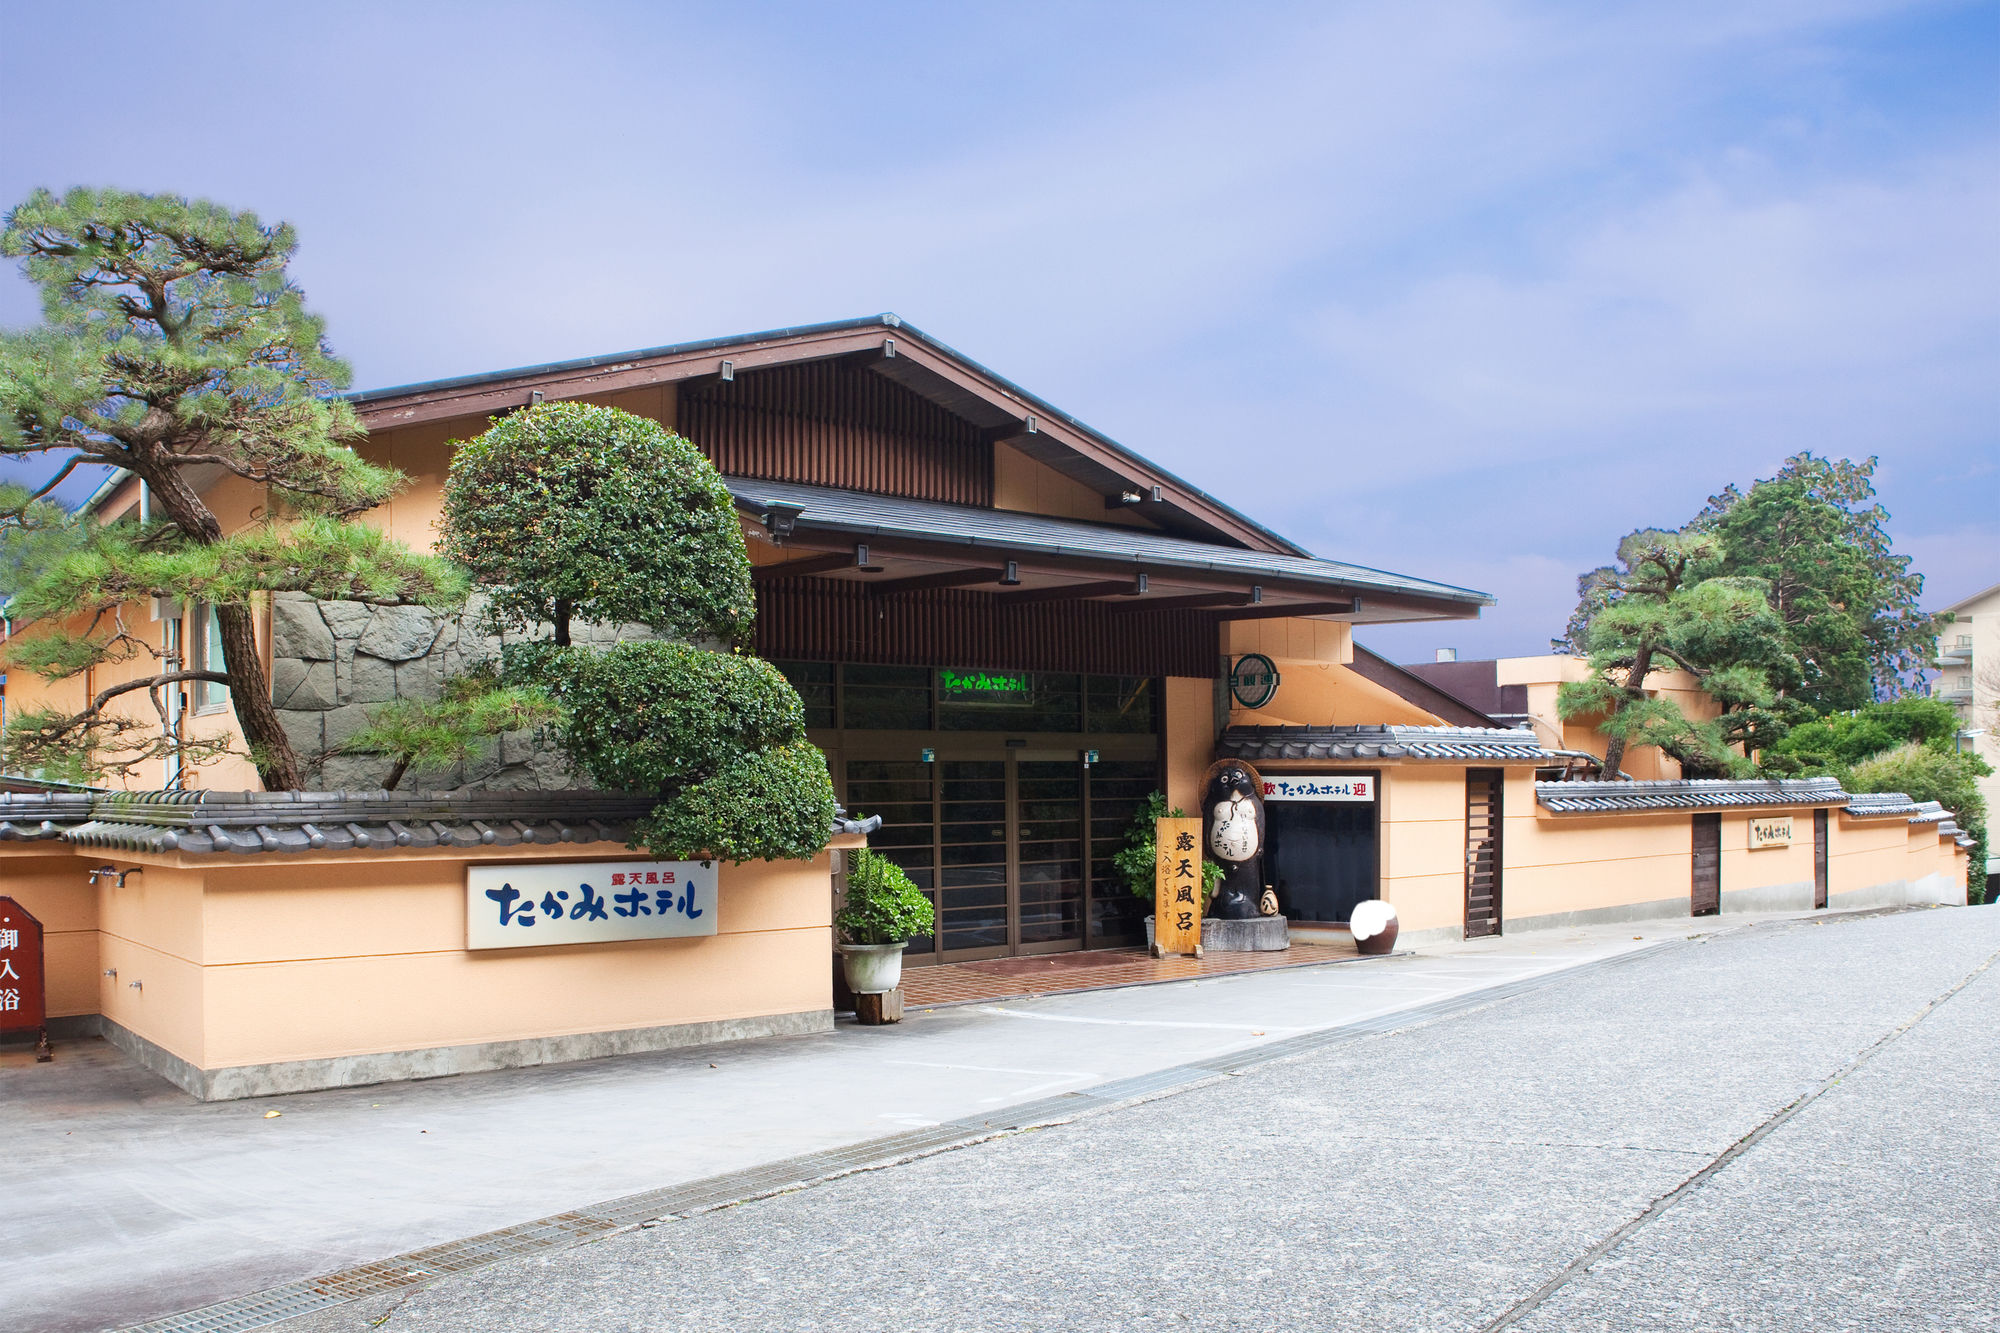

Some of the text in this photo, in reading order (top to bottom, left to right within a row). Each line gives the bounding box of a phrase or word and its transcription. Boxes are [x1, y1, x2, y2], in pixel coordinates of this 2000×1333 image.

[940, 669, 1029, 693] たかみホテル
[1263, 781, 1366, 796] 歓 たかみホテル 迎
[611, 871, 676, 886] 露天風呂
[1175, 832, 1195, 931] 露天風呂
[485, 880, 703, 927] たかみホテル
[0, 928, 21, 1011] 御入浴
